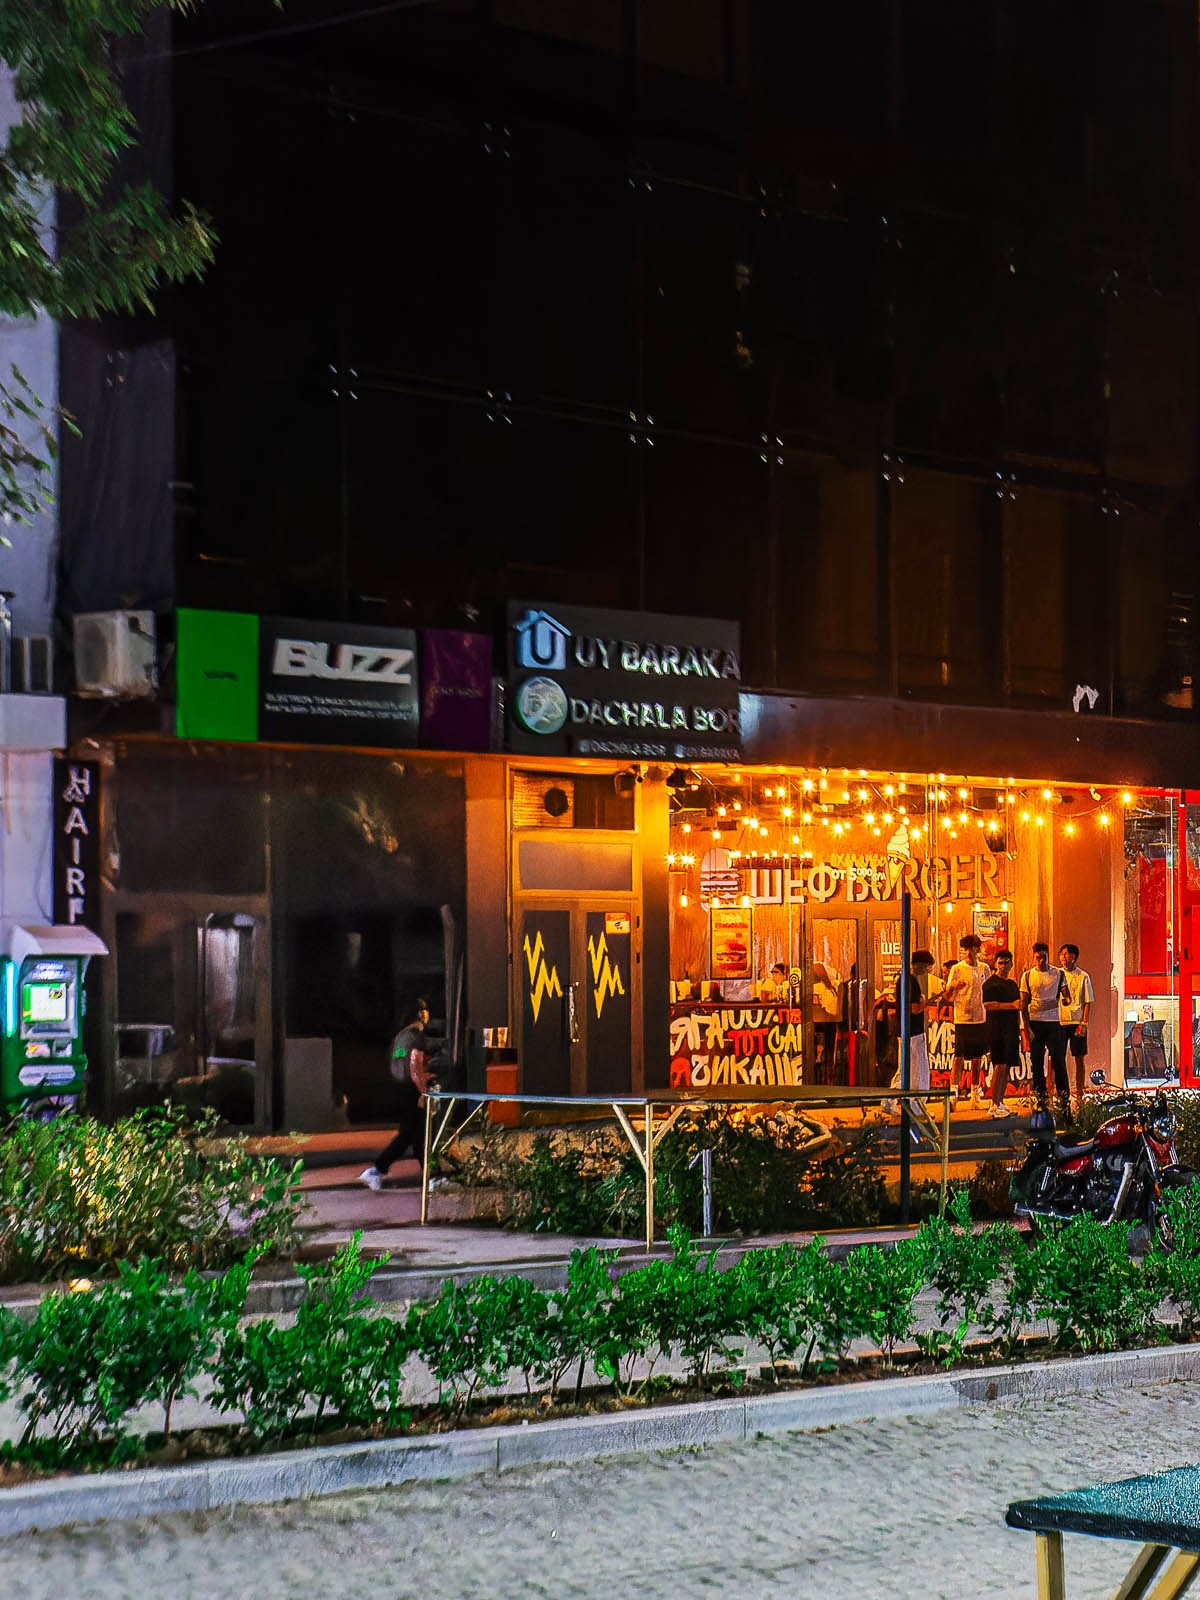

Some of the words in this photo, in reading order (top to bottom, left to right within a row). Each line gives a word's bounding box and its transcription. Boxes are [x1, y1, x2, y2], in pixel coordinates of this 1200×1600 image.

[272, 637, 414, 685] BUZZ
[619, 641, 742, 681] BARAKA
[568, 698, 689, 732] DACHALA
[751, 862, 836, 904] ШЕФ
